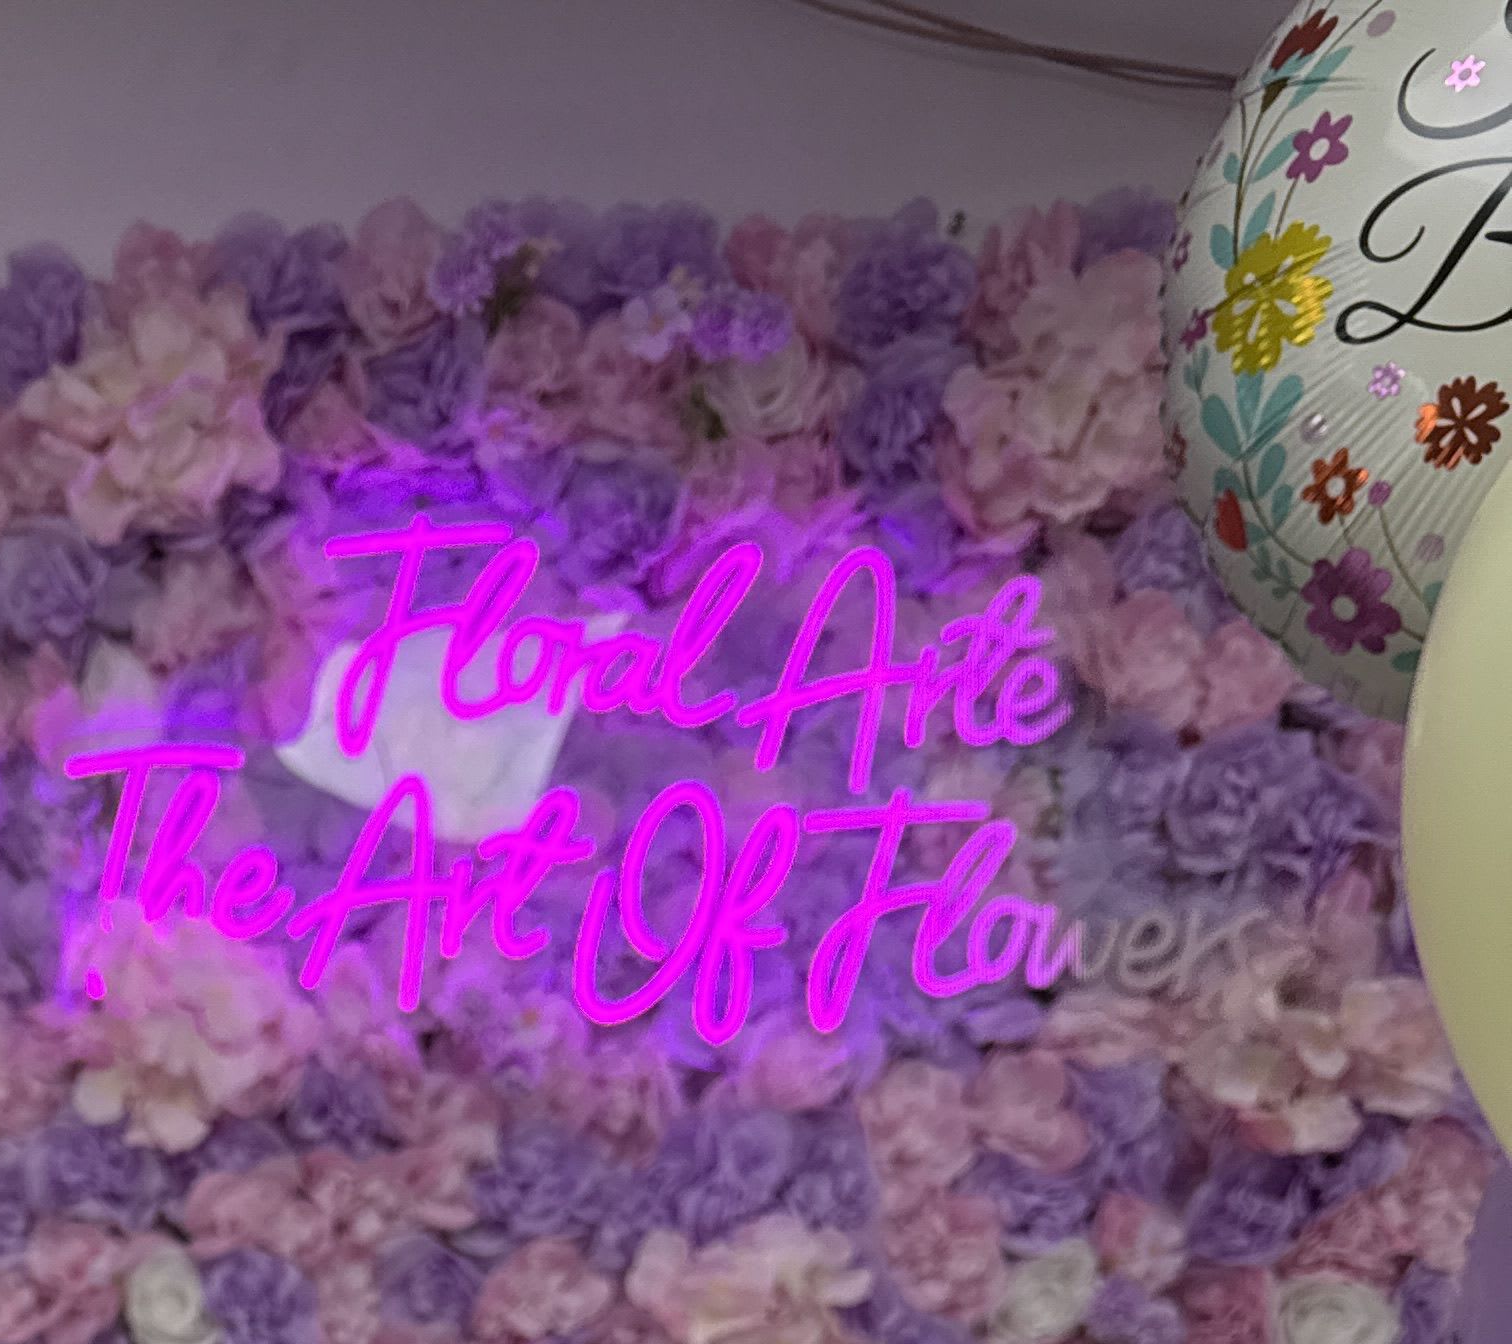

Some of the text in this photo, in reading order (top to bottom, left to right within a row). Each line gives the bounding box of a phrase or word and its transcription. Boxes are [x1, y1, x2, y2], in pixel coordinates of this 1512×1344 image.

[324, 512, 1076, 796] Floral Arte
[62, 742, 296, 970] The
[288, 770, 598, 1014] Art
[570, 778, 802, 1048] Of
